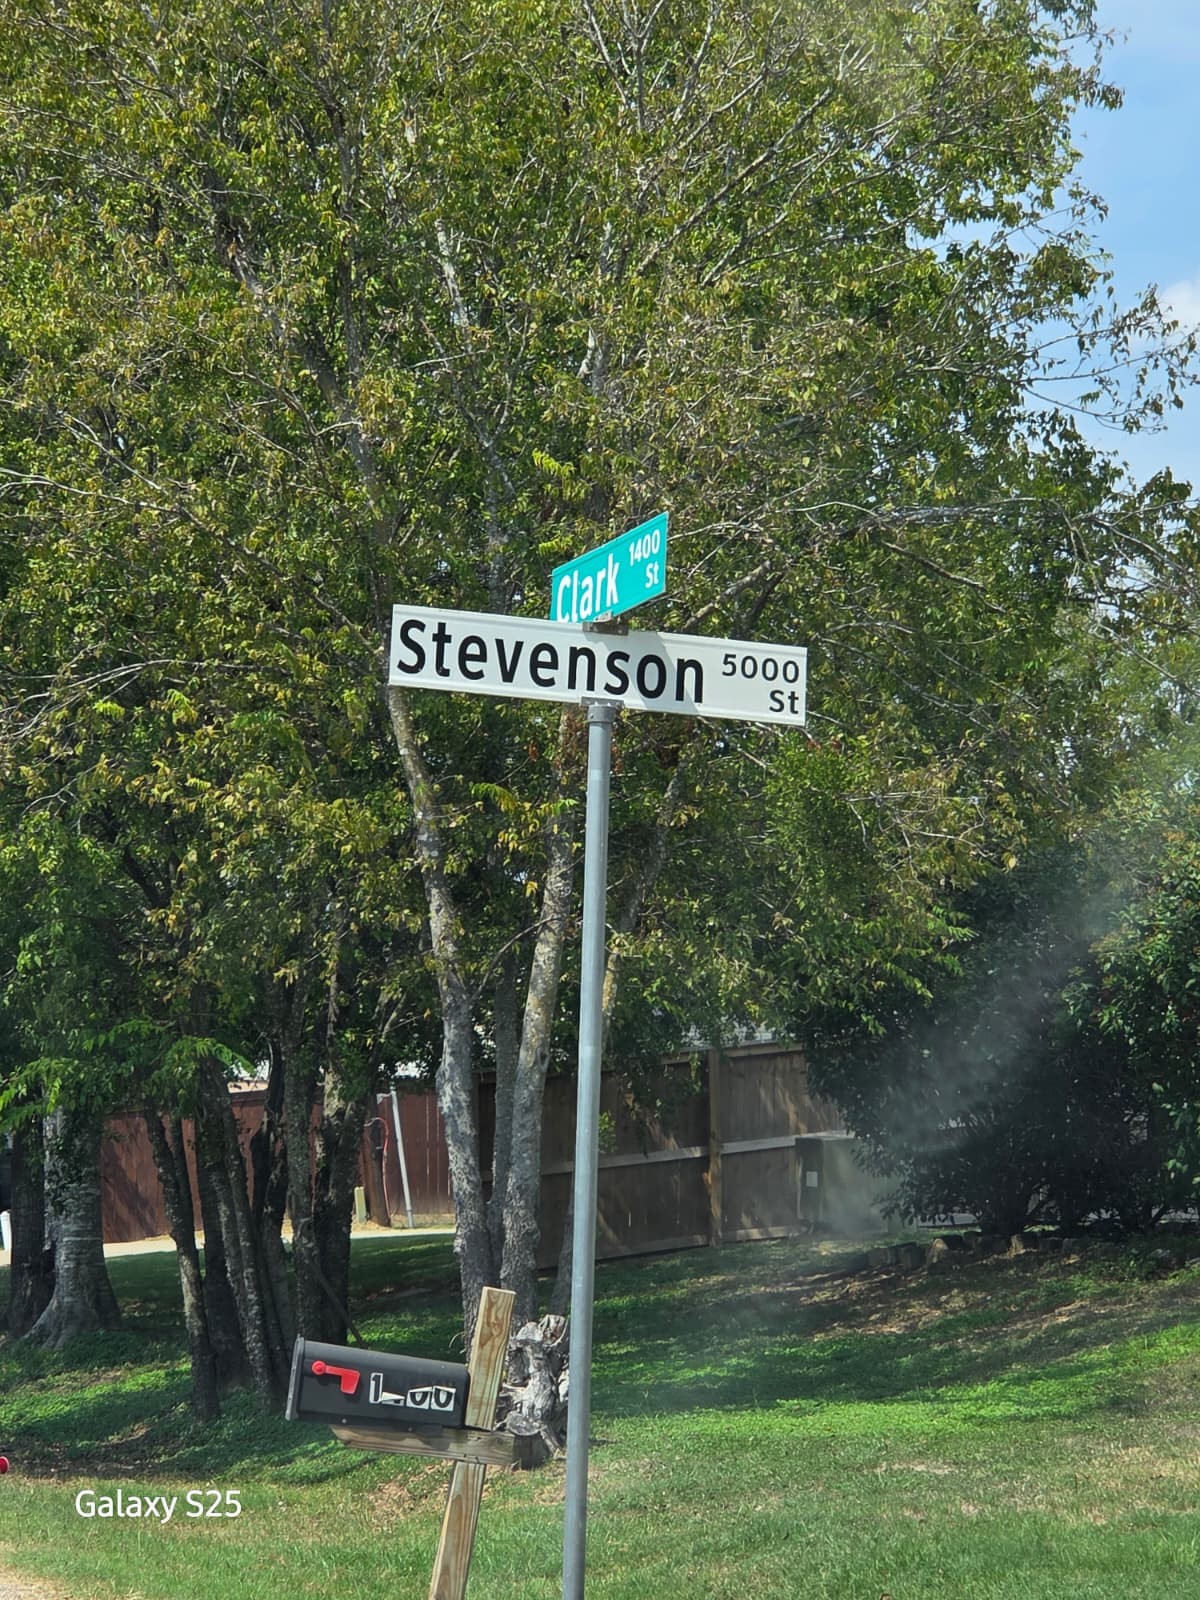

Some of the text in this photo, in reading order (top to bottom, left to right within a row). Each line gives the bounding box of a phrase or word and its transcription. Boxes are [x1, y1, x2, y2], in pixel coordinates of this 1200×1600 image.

[628, 529, 661, 567] 1400
[556, 552, 660, 624] Clark St
[397, 619, 800, 715] Stevenson St
[721, 653, 800, 683] 5000
[369, 1373, 456, 1410] 100
